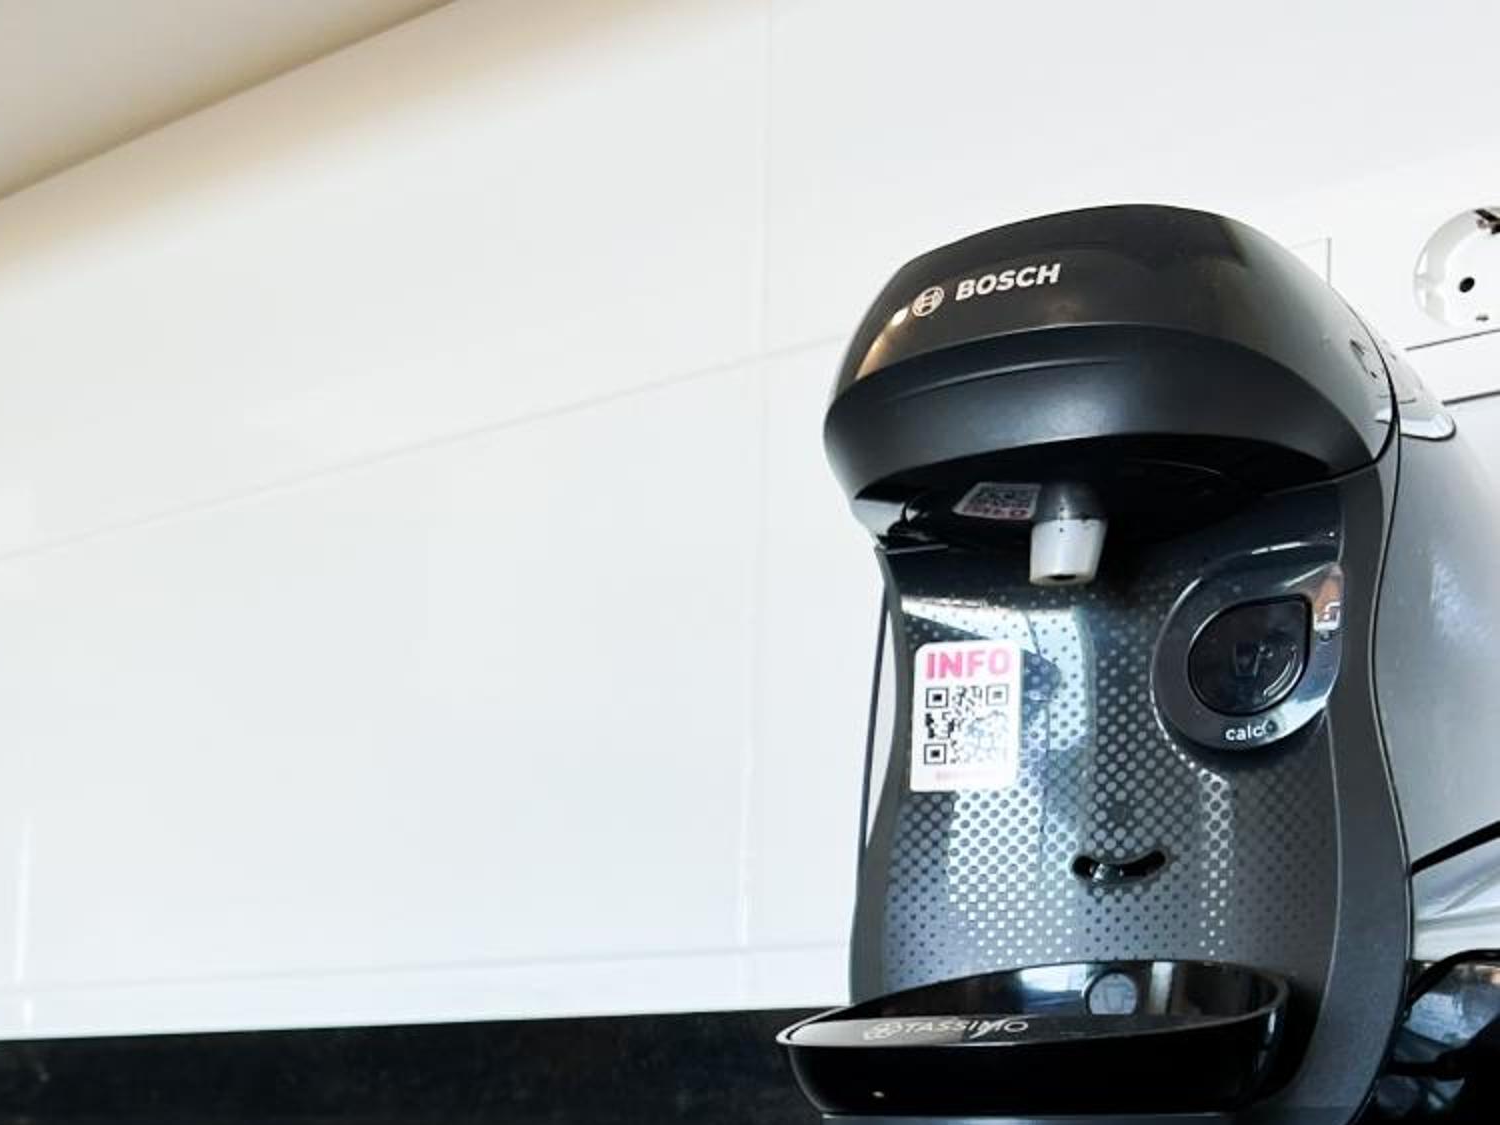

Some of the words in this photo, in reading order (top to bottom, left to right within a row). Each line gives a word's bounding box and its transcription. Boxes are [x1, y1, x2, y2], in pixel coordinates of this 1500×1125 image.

[955, 263, 1061, 301] BOSCH
[926, 649, 1010, 679] INFO
[899, 1020, 1029, 1039] TASSIMO
